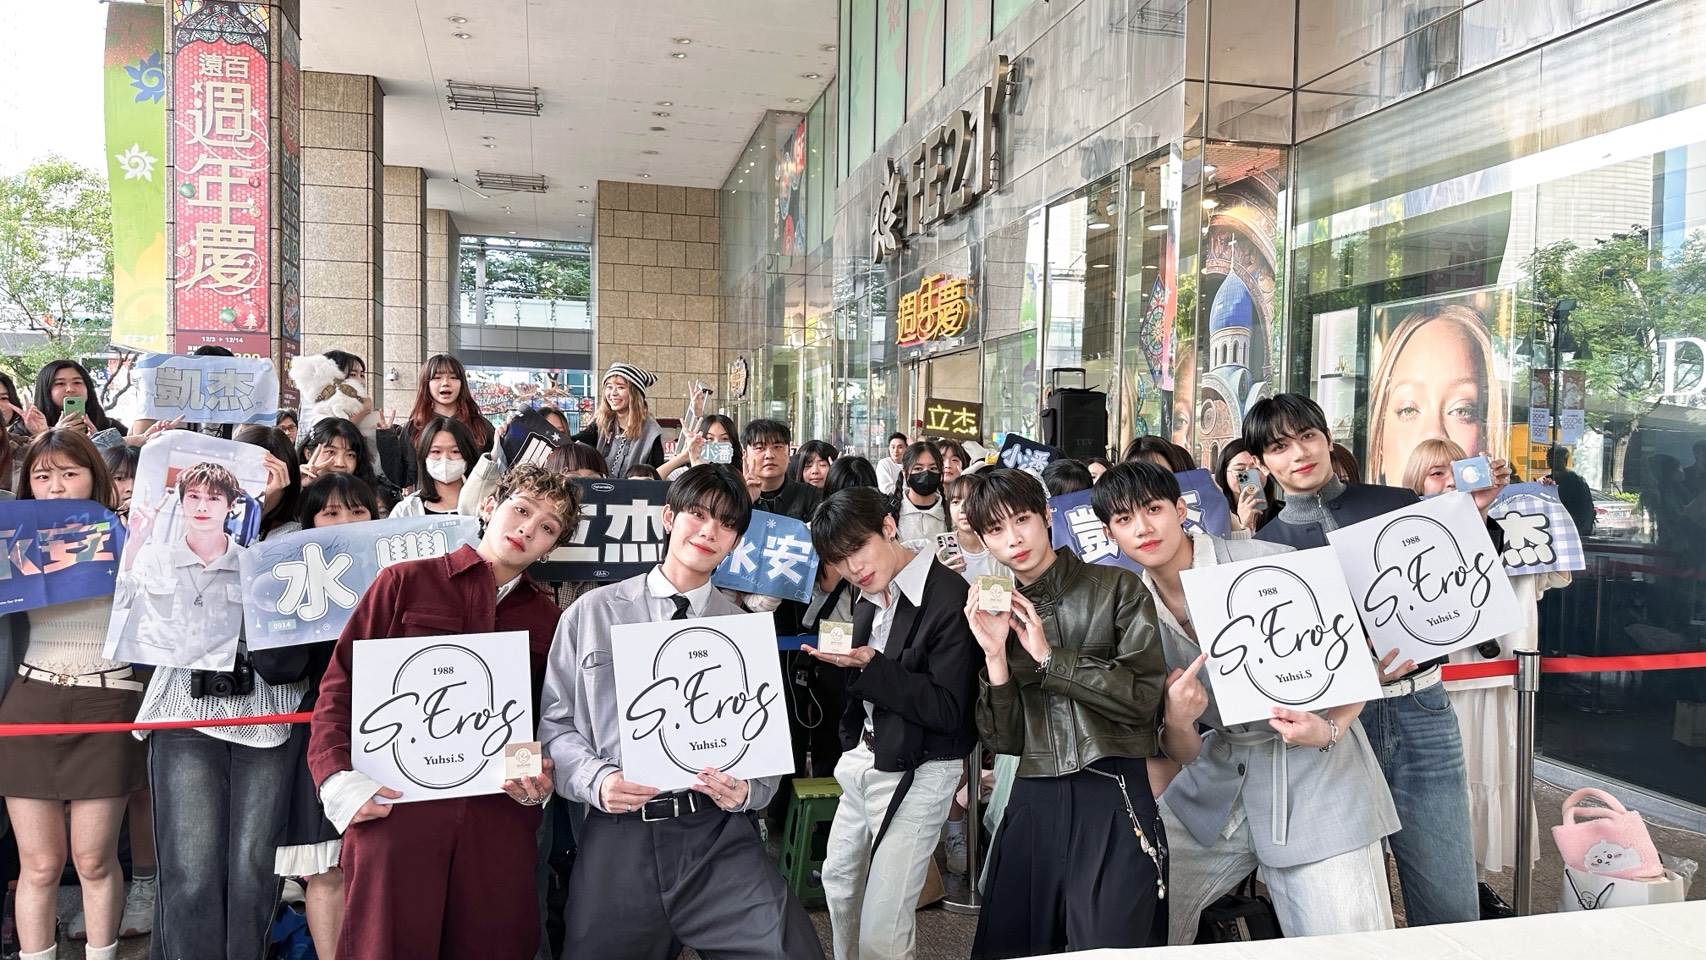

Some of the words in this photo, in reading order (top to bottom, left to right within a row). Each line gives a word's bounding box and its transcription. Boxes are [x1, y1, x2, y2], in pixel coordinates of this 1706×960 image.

[199, 53, 249, 79] 遠百
[177, 80, 268, 295] 週年慶
[895, 273, 968, 344] 週年慶
[154, 367, 255, 412] 凱杰
[926, 403, 978, 436] 立杰
[700, 442, 732, 461] 小潘
[1401, 535, 1421, 548] 1988
[1257, 586, 1278, 597] 1988
[1363, 546, 1494, 628] S.Eros
[1426, 609, 1461, 628] Yuhsi.S
[1210, 600, 1354, 676] S.Eros
[688, 650, 709, 659] 1988
[432, 666, 455, 676] 1988
[1275, 669, 1313, 684] Yuhsi.S
[625, 664, 779, 741] S.Eros
[359, 680, 525, 757] S.Eros
[688, 737, 728, 751] Yuhsi.S
[423, 753, 465, 766] Yuhsi.S
